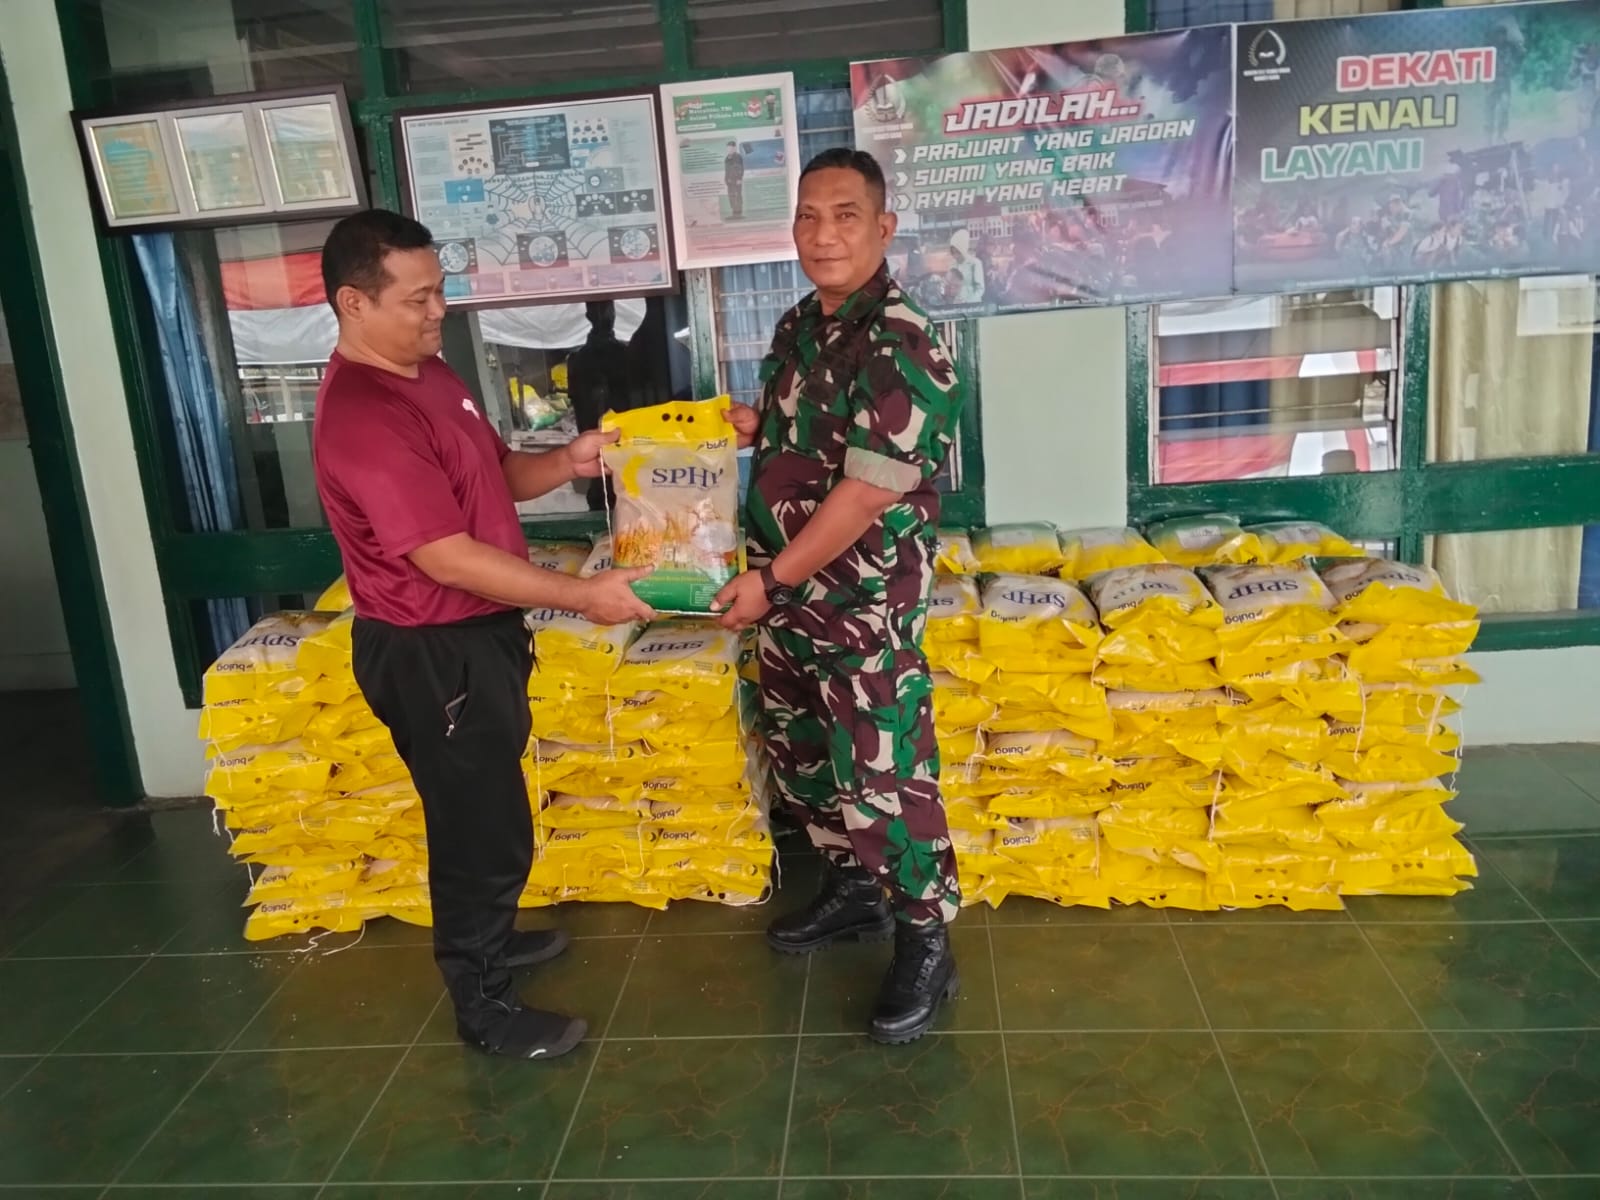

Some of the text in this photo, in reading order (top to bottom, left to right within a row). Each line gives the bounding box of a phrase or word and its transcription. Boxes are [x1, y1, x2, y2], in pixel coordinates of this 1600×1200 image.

[1336, 47, 1497, 92] DEKATI
[945, 89, 1138, 133] JADILAH...
[1299, 94, 1458, 136] KENALI
[912, 119, 1196, 163] PRAJURIT YANG JAGOAN
[914, 152, 1116, 187] SUAMI YANG BAIK
[1261, 138, 1425, 182] LAYANI
[915, 174, 1127, 210] AYAH YANG HEBAT
[1000, 591, 1066, 609] SPHP
[1227, 580, 1299, 600] SPHP
[640, 639, 704, 654] SPHP
[216, 663, 246, 672] bulog
[554, 831, 581, 842] bulog
[662, 831, 689, 842] bulog
[1001, 834, 1031, 847] bulog
